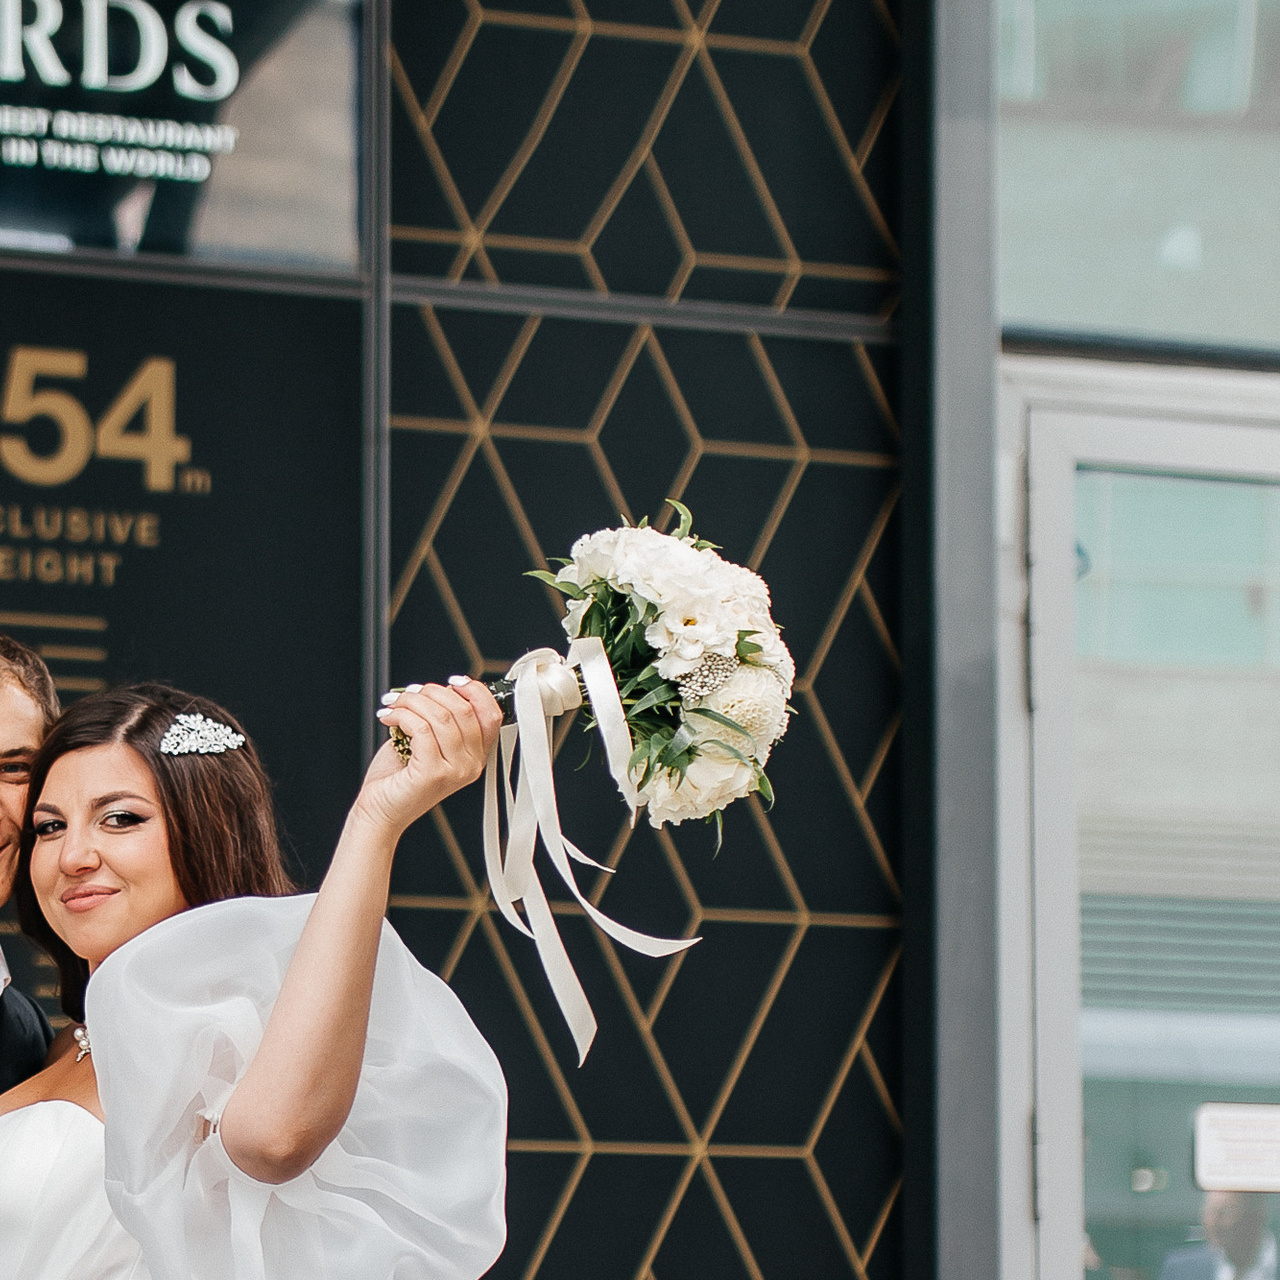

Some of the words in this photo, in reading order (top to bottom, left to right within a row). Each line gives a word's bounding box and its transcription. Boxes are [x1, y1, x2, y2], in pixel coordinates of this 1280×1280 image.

[52, 109, 239, 154] RESTAURANT
[1, 136, 38, 167] IN
[40, 139, 100, 174] THE
[100, 145, 212, 183] WORLD
